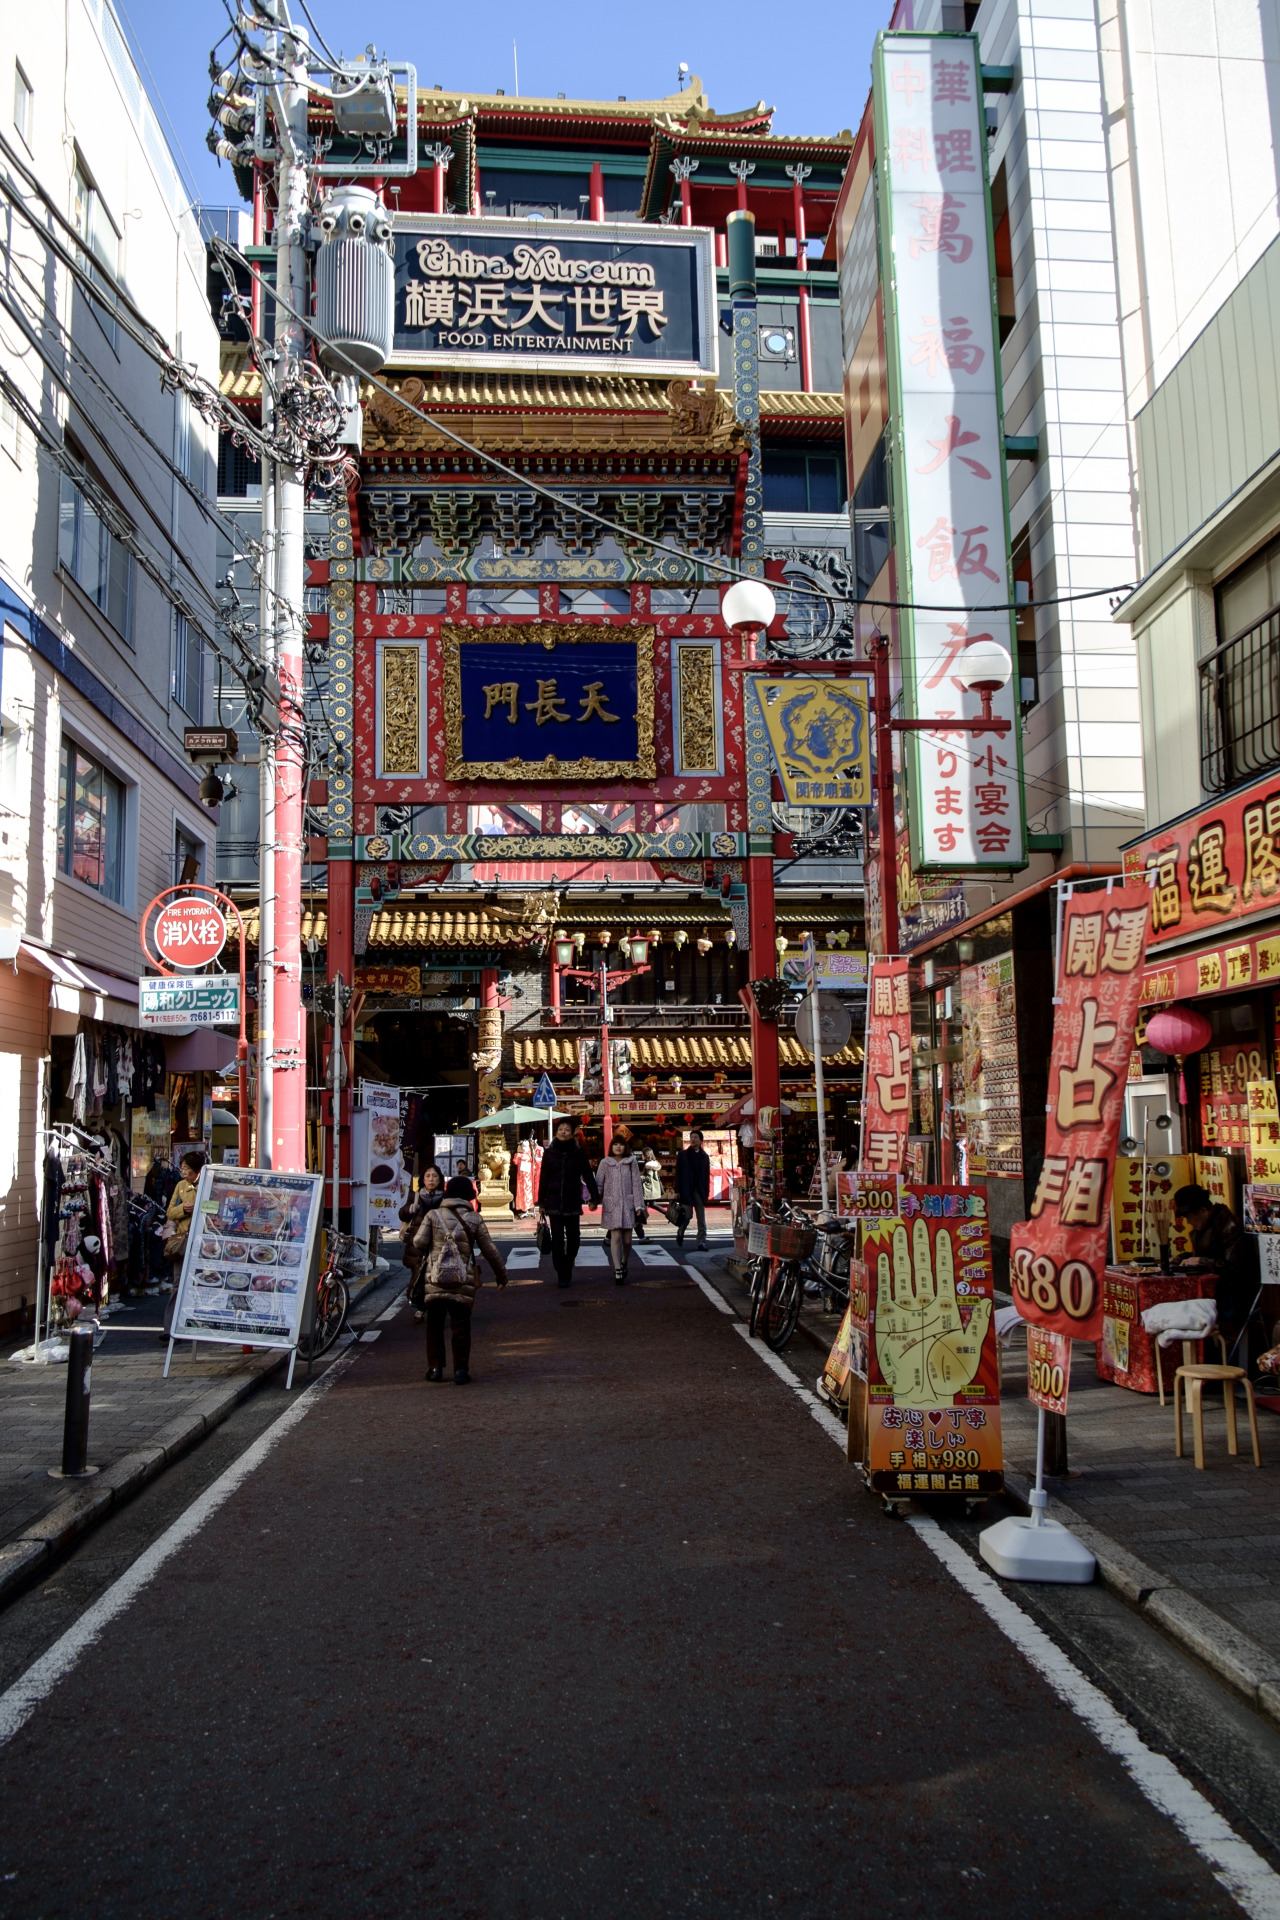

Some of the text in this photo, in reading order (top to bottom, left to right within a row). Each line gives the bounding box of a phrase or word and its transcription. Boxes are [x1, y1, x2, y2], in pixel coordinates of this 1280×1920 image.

[891, 59, 972, 107] 中華
[891, 127, 976, 174] 料理
[416, 239, 655, 287] China Museum
[404, 279, 668, 338] 横浜大世界
[438, 332, 633, 352] FOOD ENTERTAINMENT
[167, 907, 212, 916] FIRE HYDRANT
[162, 918, 220, 947] 消火栓
[1064, 902, 1149, 978] 開運
[830, 954, 861, 965] ドクター
[1227, 951, 1250, 980] 丁寧
[149, 980, 193, 990] 健康保険医
[1199, 962, 1220, 988] 安心
[143, 989, 235, 1012] 陽和クリニック
[873, 973, 910, 1016] 開運
[1139, 979, 1157, 1001] 人気
[198, 1011, 235, 1022] 681-5117
[874, 1029, 910, 1116] 占
[1056, 996, 1117, 1132] 占
[1250, 1088, 1276, 1110] 安心
[1252, 1121, 1280, 1144] 丁寧
[841, 1190, 893, 1209] ¥500
[1030, 1156, 1106, 1226] 手相
[843, 1208, 895, 1216] タイムサービス
[901, 1193, 987, 1217] 手相鑑定
[961, 1224, 983, 1236] 恋愛
[961, 1245, 984, 1257] 結婚
[963, 1266, 986, 1277] 相性
[883, 1407, 986, 1429] 安心 丁寧
[904, 1428, 965, 1449] 楽しい
[890, 1449, 979, 1469] 手相 ¥980
[897, 1474, 980, 1490] 福運閣占館
